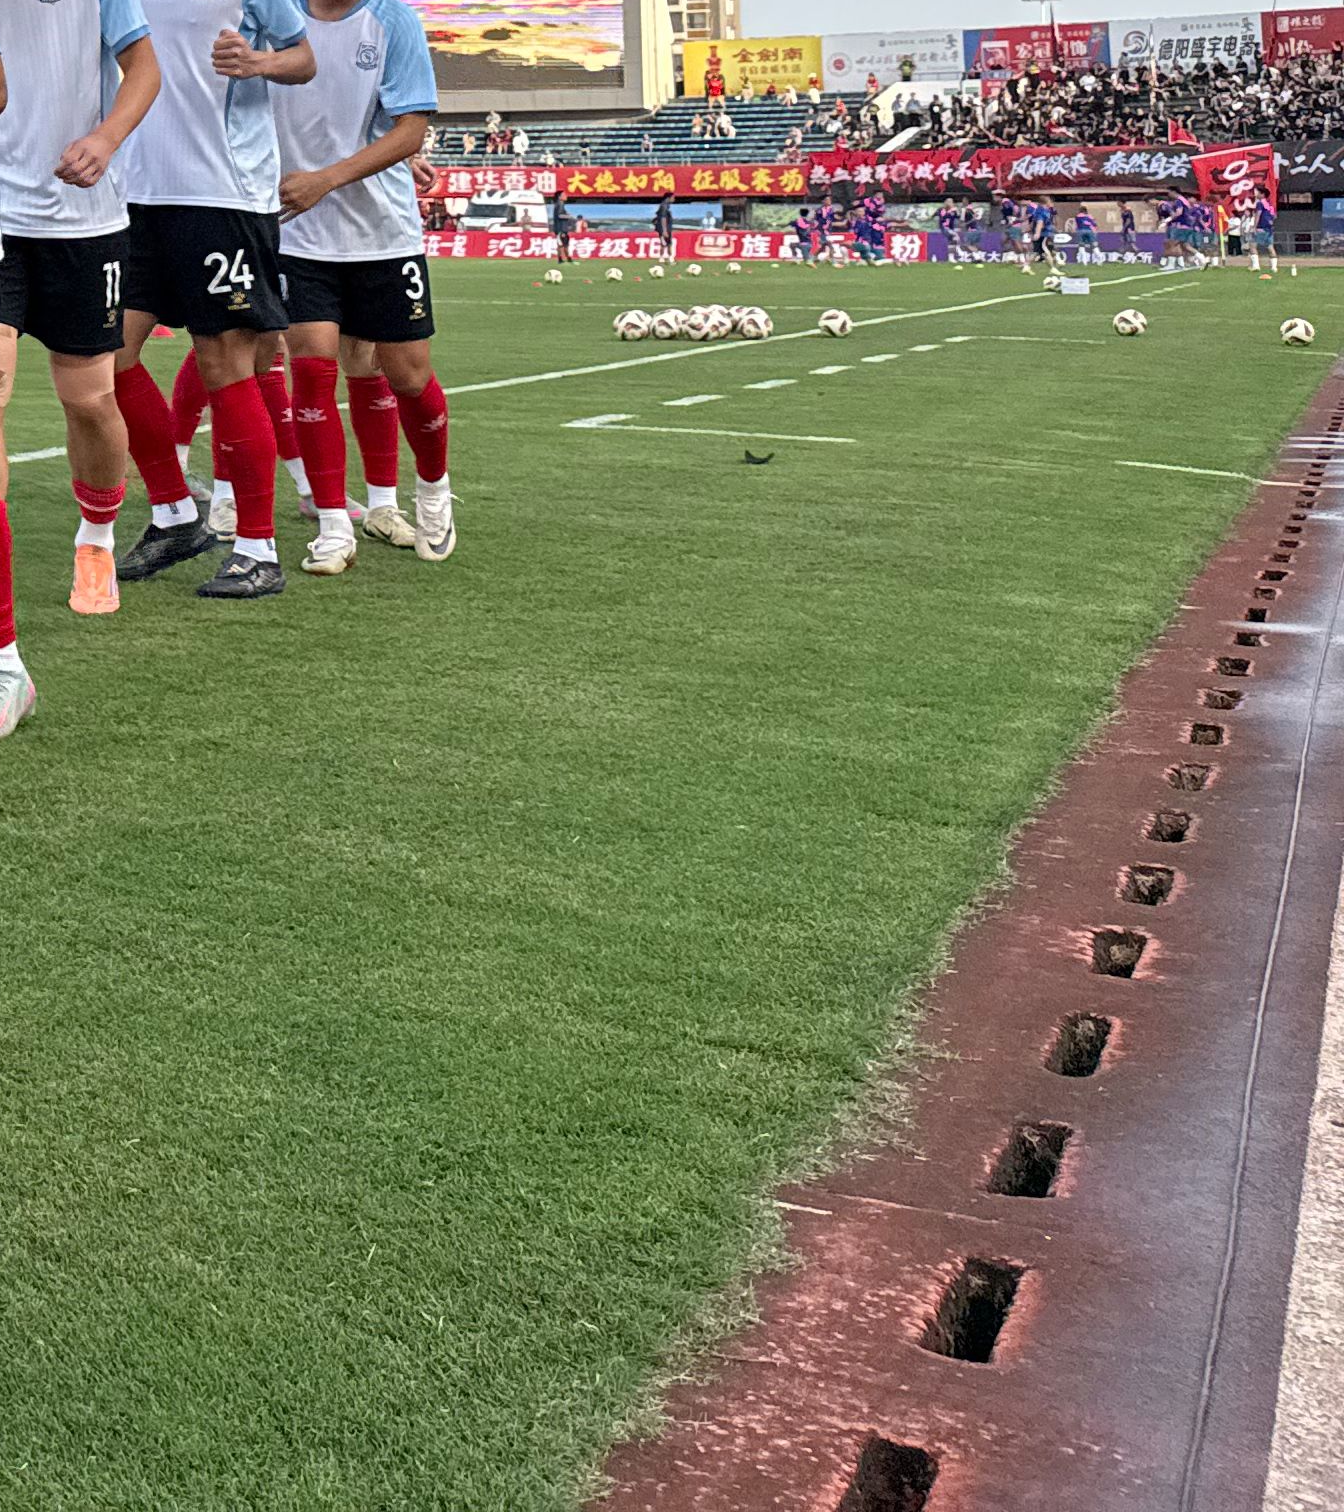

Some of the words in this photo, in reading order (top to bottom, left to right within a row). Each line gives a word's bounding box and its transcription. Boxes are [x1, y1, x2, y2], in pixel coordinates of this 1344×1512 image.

[1014, 39, 1089, 59] 宏冠饰
[448, 170, 557, 194] 建华香油
[691, 167, 805, 193] 征服赛场
[1007, 152, 1093, 182] 风雨欲来
[1101, 151, 1192, 182] 泰然自若
[102, 259, 122, 310] 11
[203, 248, 255, 294] 24
[400, 260, 426, 300] 3
